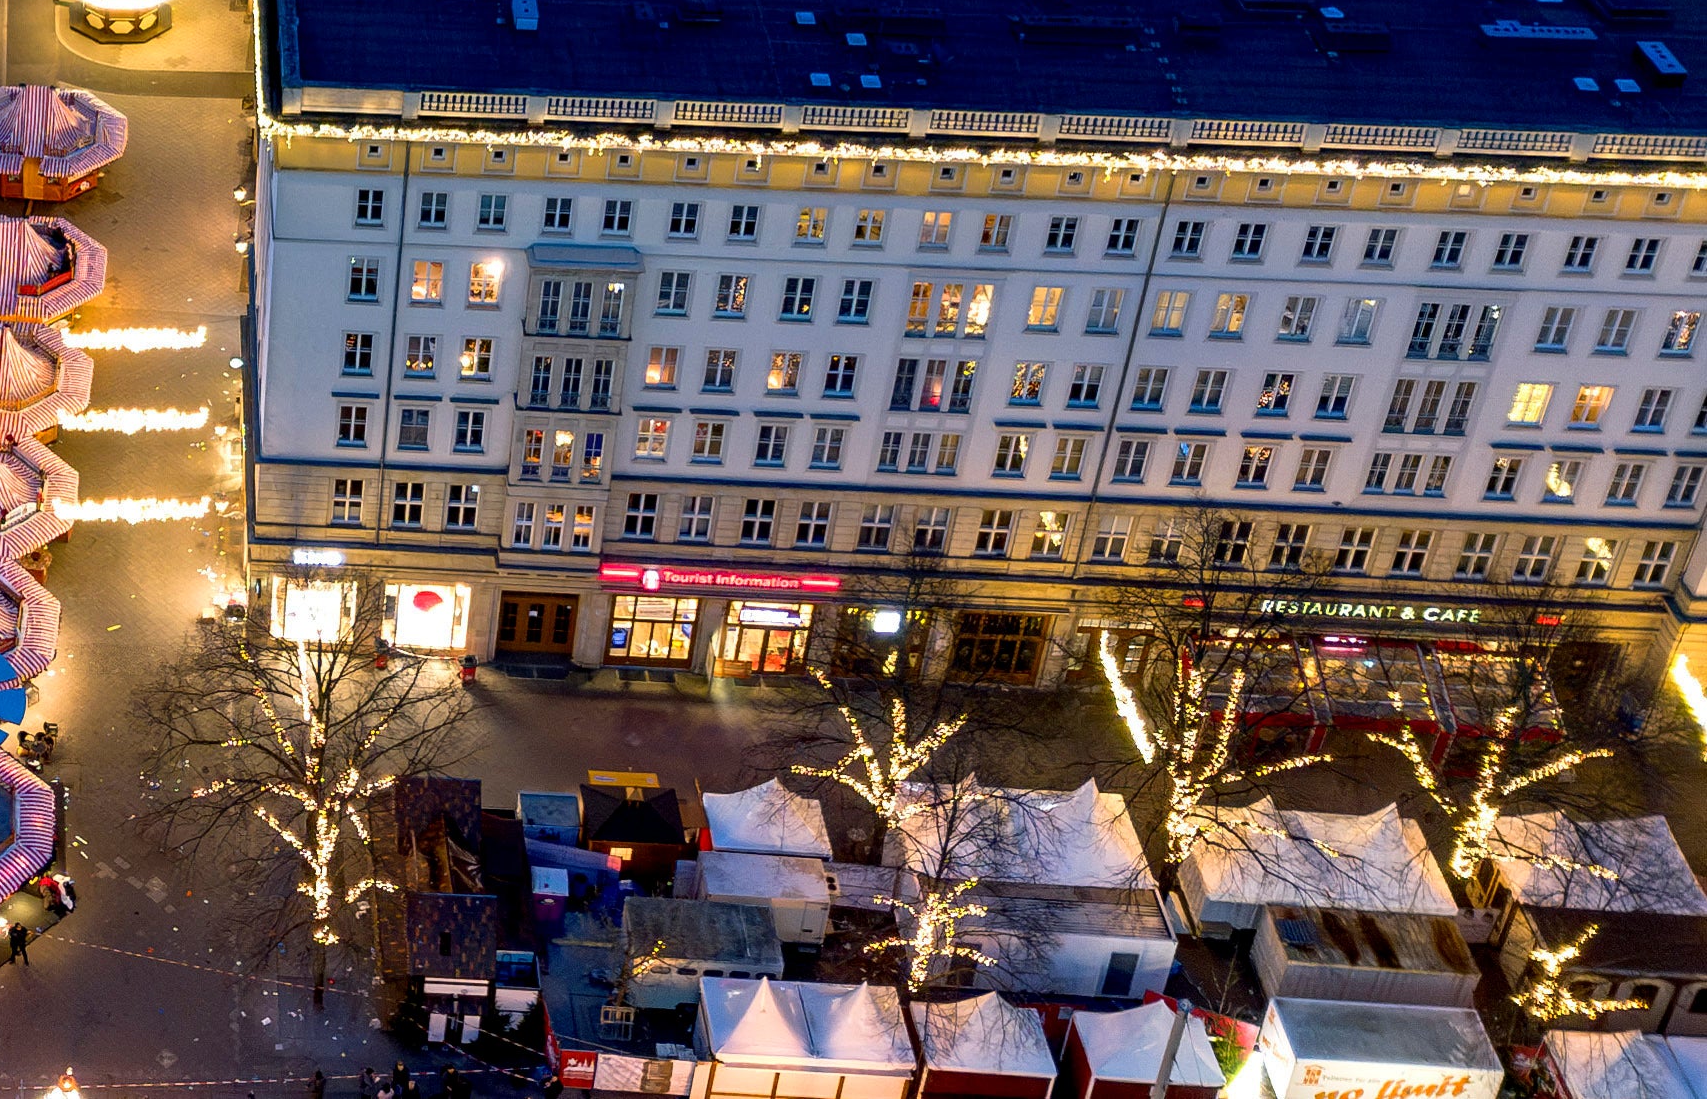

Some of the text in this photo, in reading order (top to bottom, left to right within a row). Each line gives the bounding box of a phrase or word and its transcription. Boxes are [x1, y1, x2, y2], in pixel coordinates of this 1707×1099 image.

[663, 571, 799, 589] Tourist Information
[1261, 599, 1396, 618] RESTAURANT
[1401, 606, 1415, 621] &
